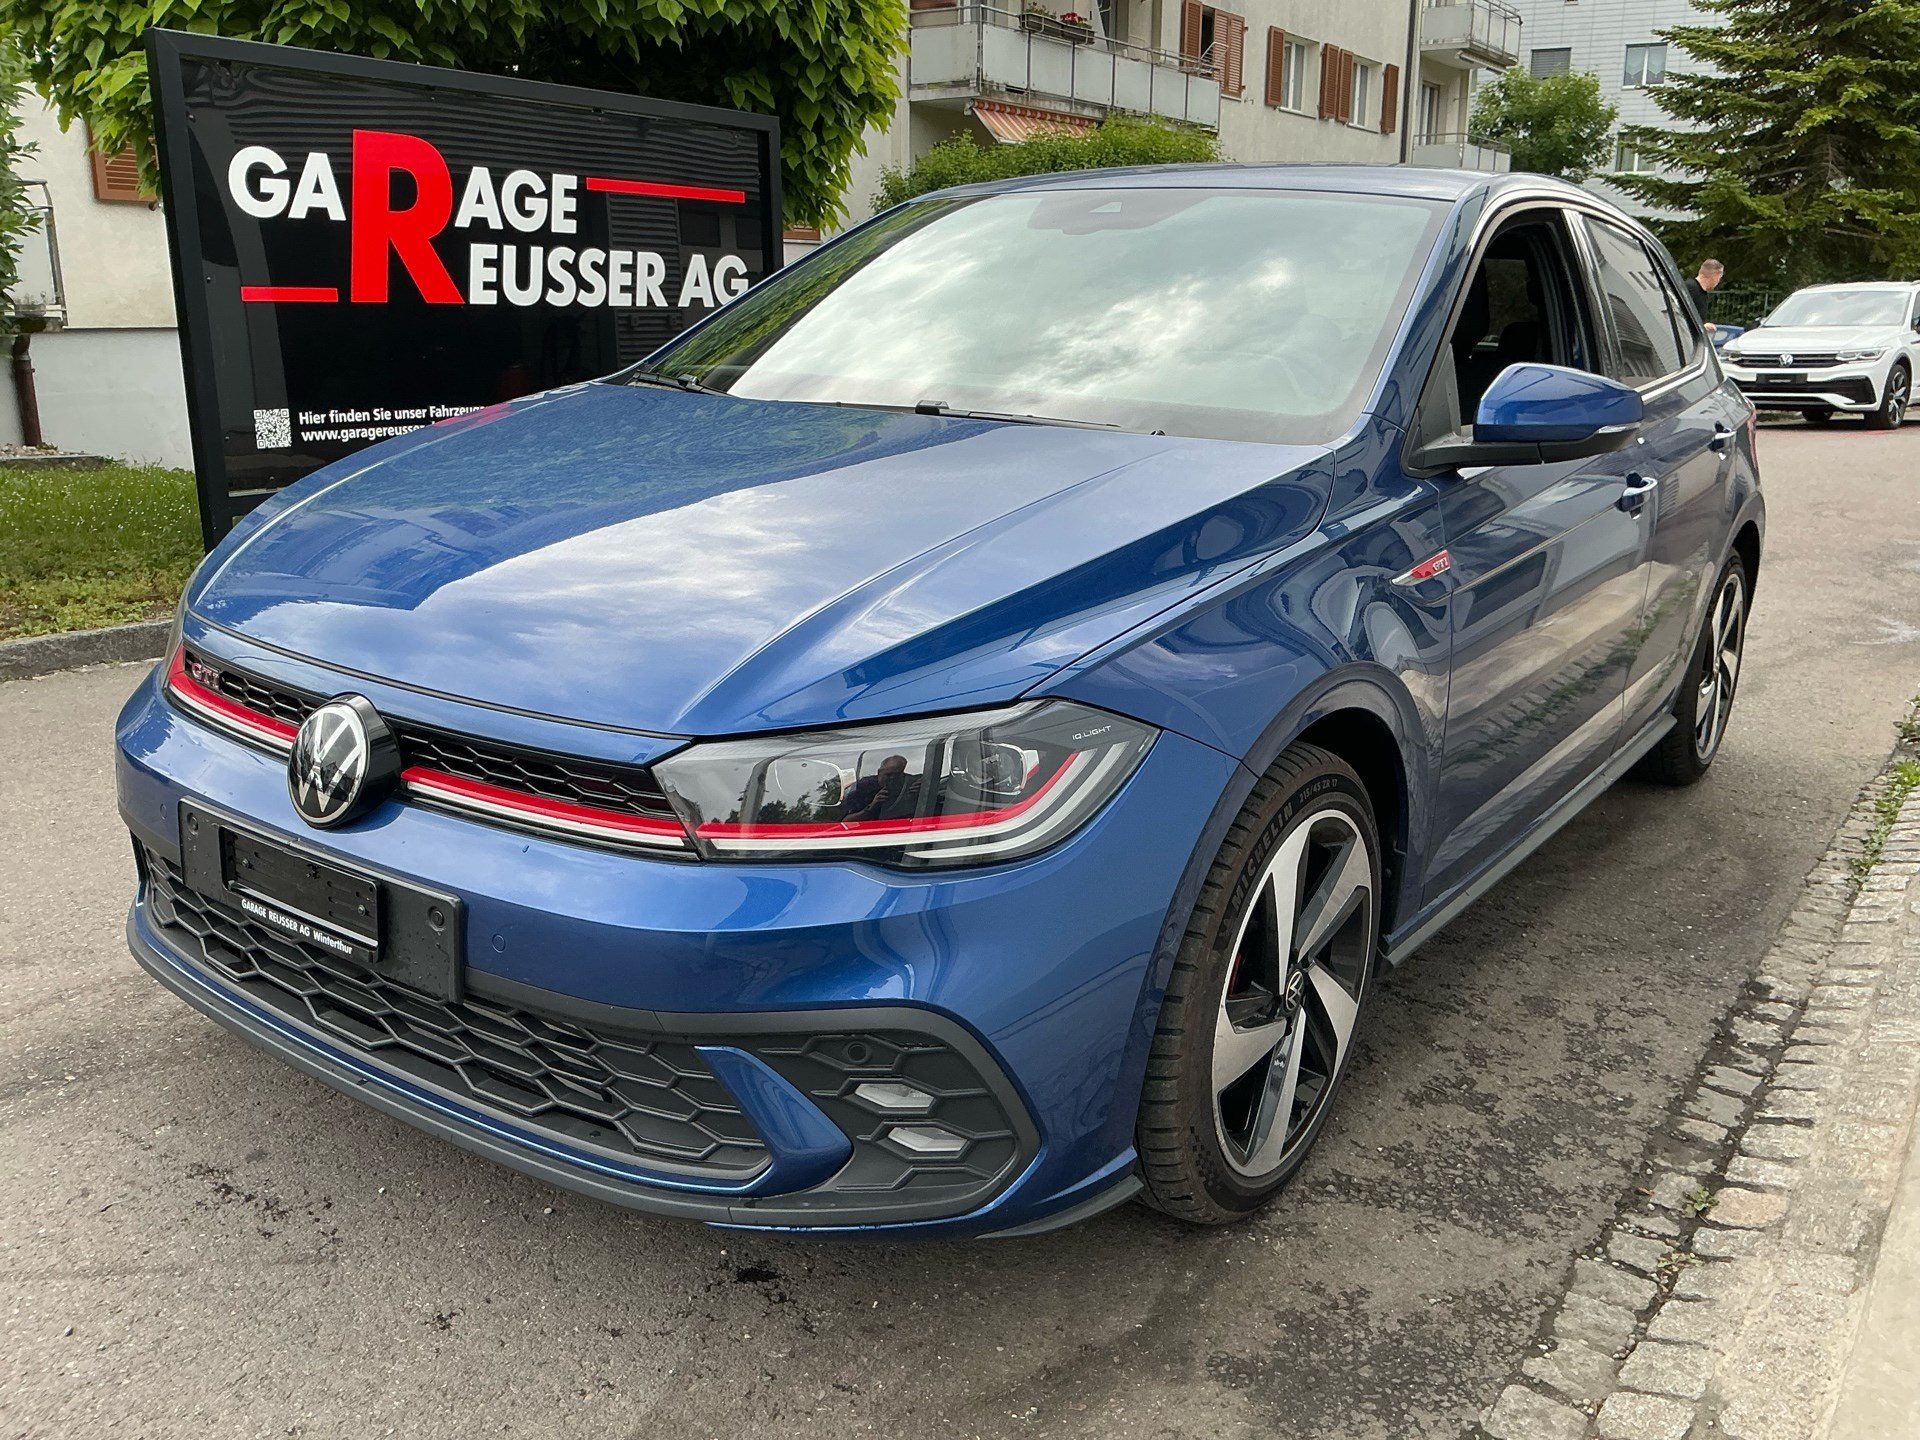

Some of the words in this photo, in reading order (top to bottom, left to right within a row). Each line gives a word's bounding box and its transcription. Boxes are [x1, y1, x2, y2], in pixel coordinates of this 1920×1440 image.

[228, 129, 577, 304] GARAGE
[678, 254, 749, 307] AG
[299, 411, 327, 425] Hier
[329, 409, 370, 423] finden
[373, 407, 391, 420] Sie
[394, 407, 427, 420] unser
[430, 404, 485, 418] Fahrzeu
[301, 424, 426, 442] www.garagereusse
[1432, 557, 1448, 571] GTI
[191, 662, 220, 690] GTI
[1231, 801, 1294, 914] MICHELIN
[241, 899, 267, 918] GARAGE
[268, 910, 298, 932] REUSSER
[299, 924, 310, 937] AG
[313, 929, 353, 955] Winterthur
